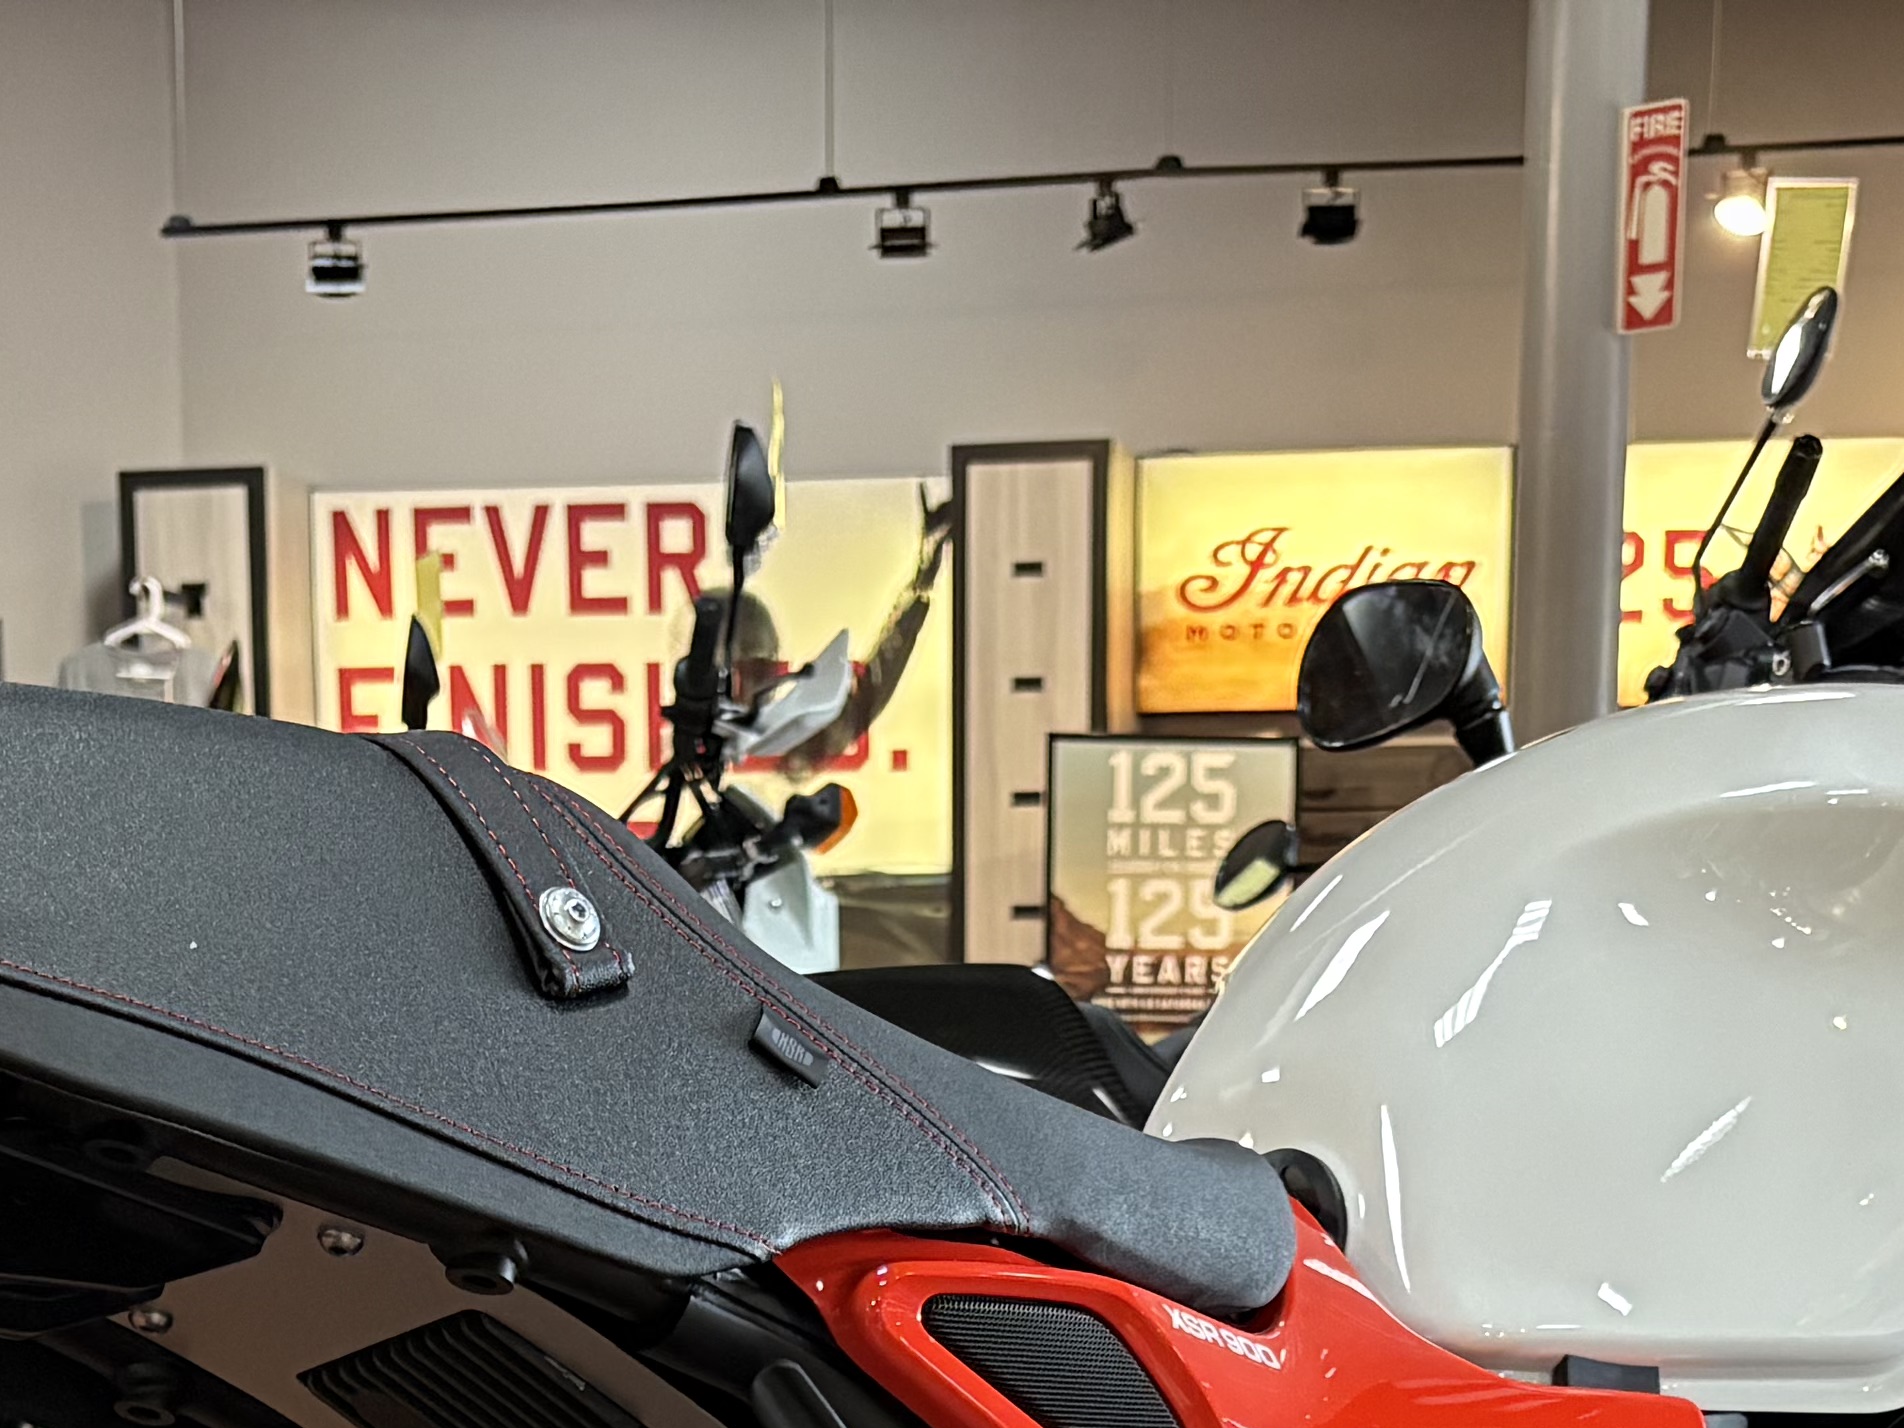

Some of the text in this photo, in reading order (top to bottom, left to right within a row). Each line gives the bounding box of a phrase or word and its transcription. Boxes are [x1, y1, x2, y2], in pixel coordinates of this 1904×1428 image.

[1629, 111, 1683, 140] FIRE
[332, 501, 706, 621] NEVER
[1107, 751, 1237, 824] 125
[1107, 827, 1234, 858] MILES
[1105, 877, 1233, 950] 125
[1105, 955, 1231, 985] YEARS
